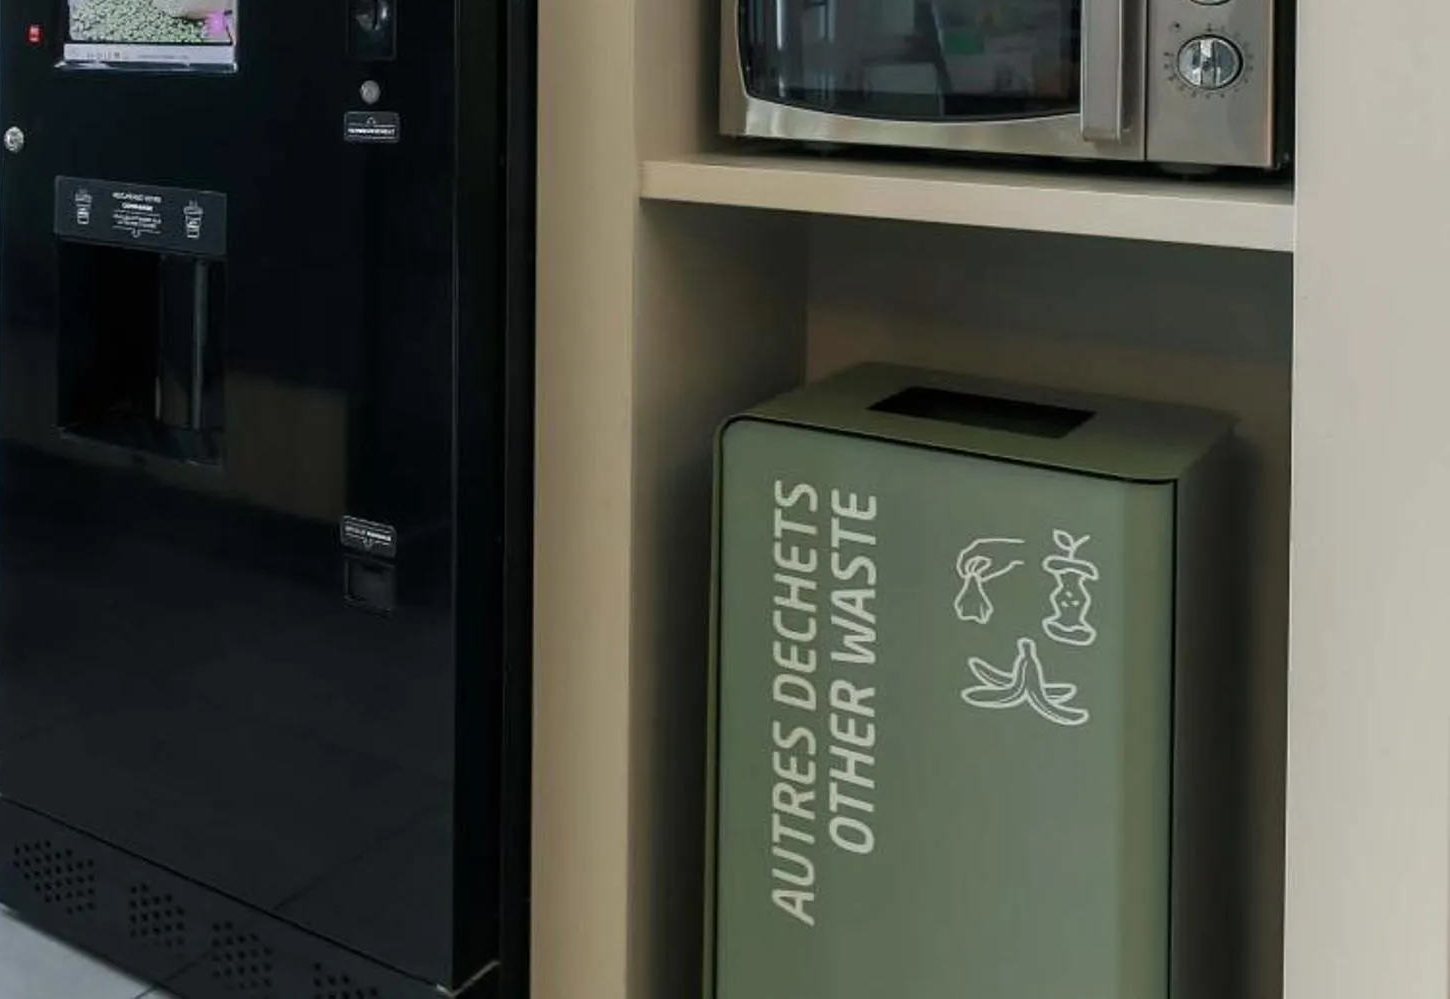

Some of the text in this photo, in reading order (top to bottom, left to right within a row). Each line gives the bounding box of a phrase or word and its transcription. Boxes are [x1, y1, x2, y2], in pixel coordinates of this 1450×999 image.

[771, 479, 818, 926] AUTRES DECHETS
[829, 488, 877, 855] OTHER WASTE
